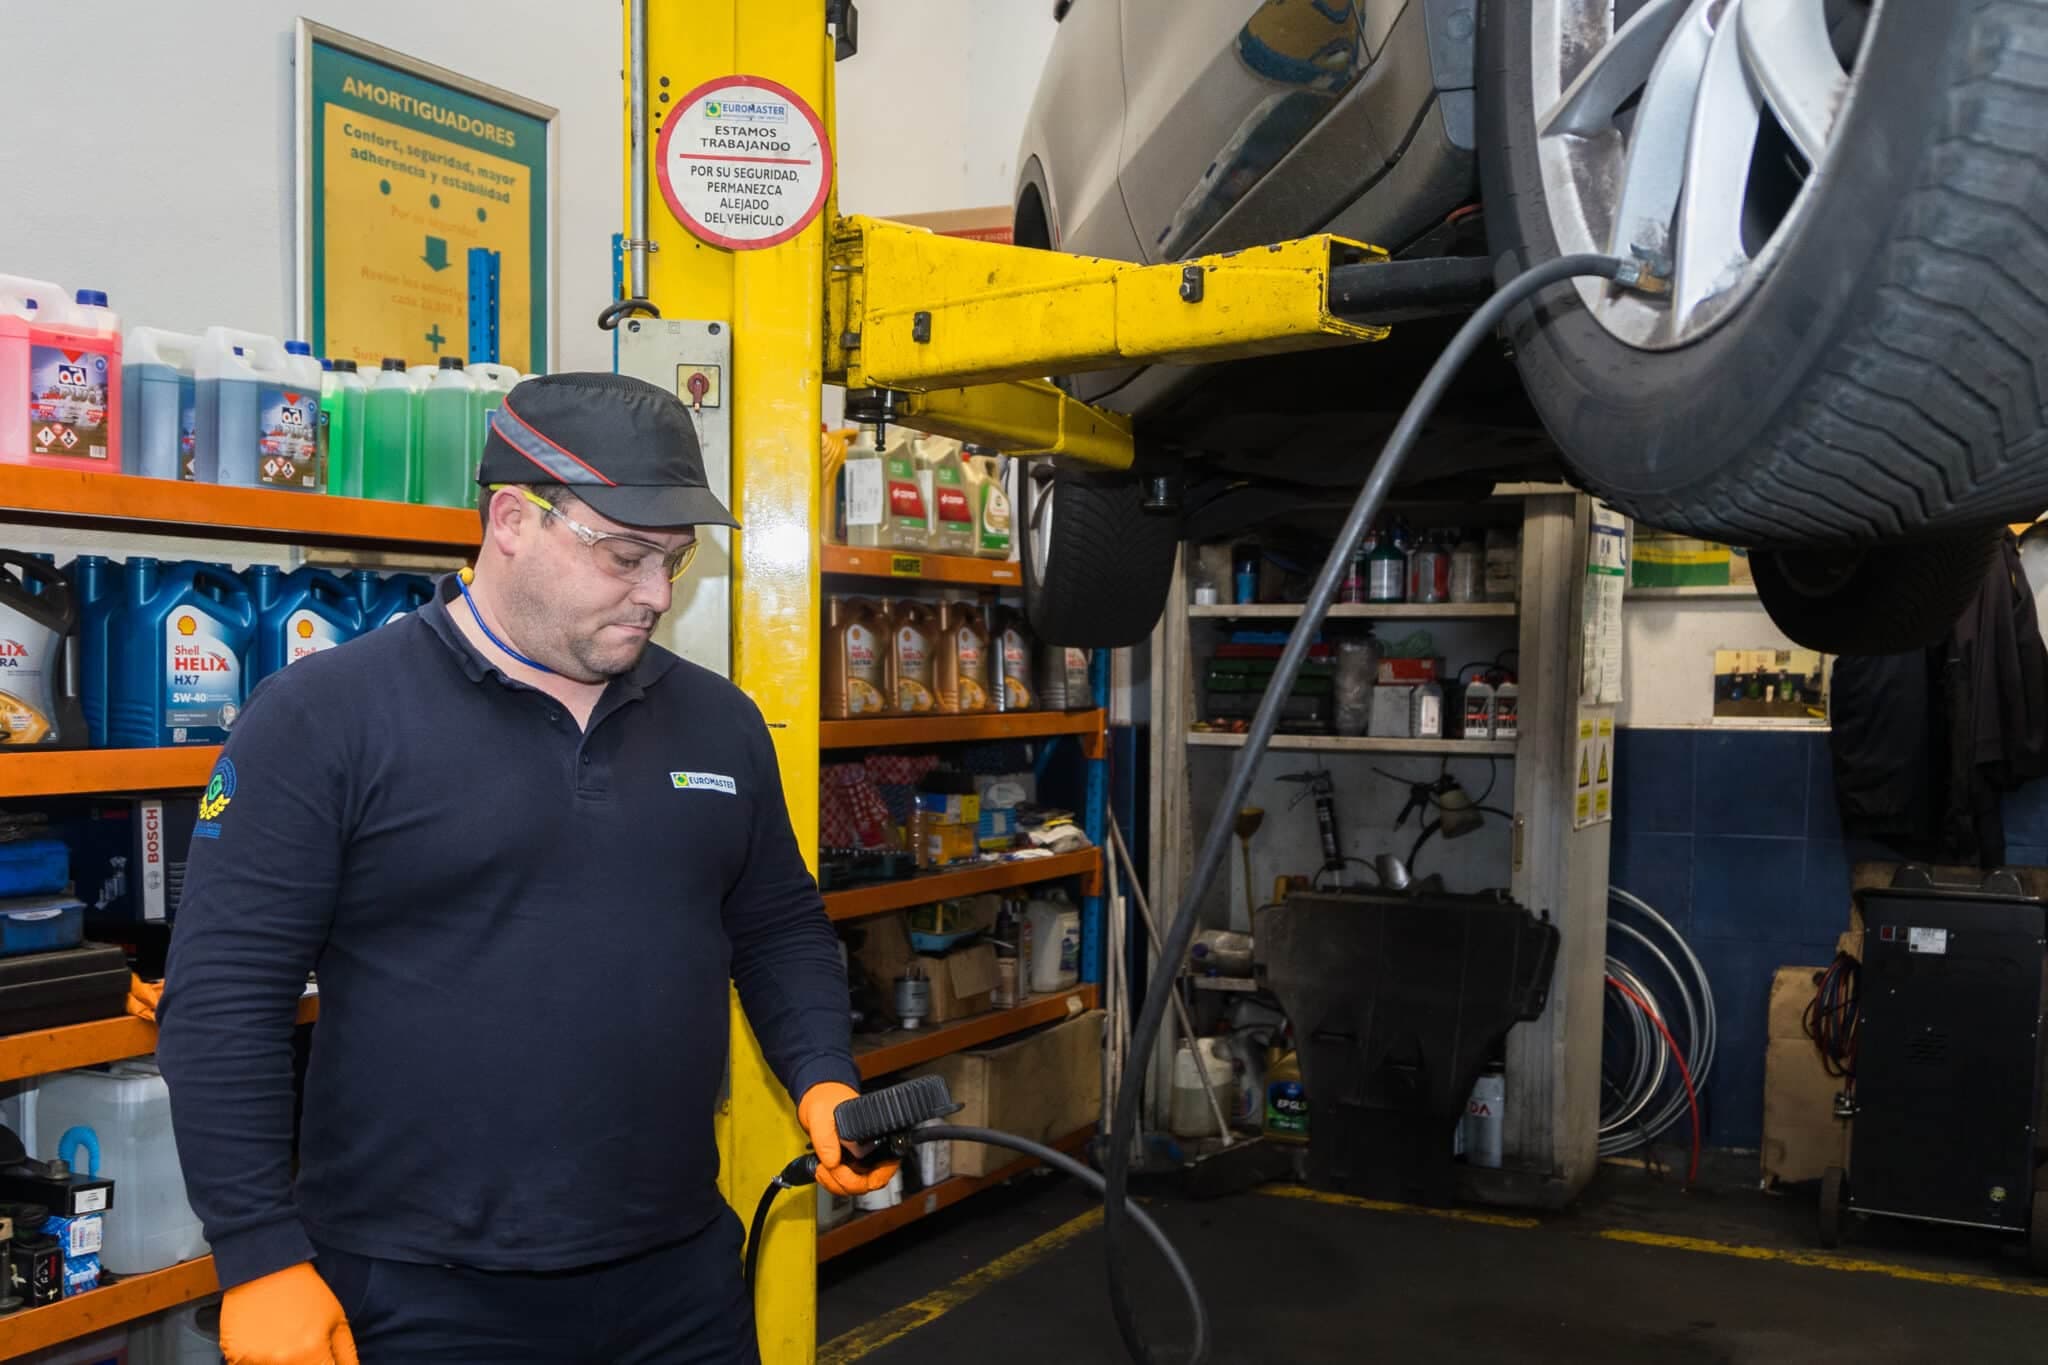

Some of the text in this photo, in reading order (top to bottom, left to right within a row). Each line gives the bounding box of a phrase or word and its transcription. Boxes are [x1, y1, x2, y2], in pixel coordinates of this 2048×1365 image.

[342, 76, 516, 148] AMORTIGUADORES
[723, 104, 784, 115] EUROMASTER
[715, 125, 777, 138] ESTAMOS
[700, 138, 791, 152] TRABAJANDO
[343, 123, 516, 186] Confort, seguridad, mayor
[351, 147, 510, 204] adherencia y estabilidad
[691, 165, 800, 183] POR SU SEGURIDAD,
[707, 181, 783, 196] PERMANEZCA
[720, 198, 769, 211] ALEJADO
[704, 211, 785, 226] DEL VEHÍCULO
[0, 644, 29, 657] LIX
[175, 645, 200, 656] Shell
[175, 656, 231, 672] HELIX
[175, 675, 201, 686] HX7
[172, 692, 207, 704] 5W-40
[689, 776, 735, 789] EUROMASTER
[146, 809, 159, 864] BOSCH
